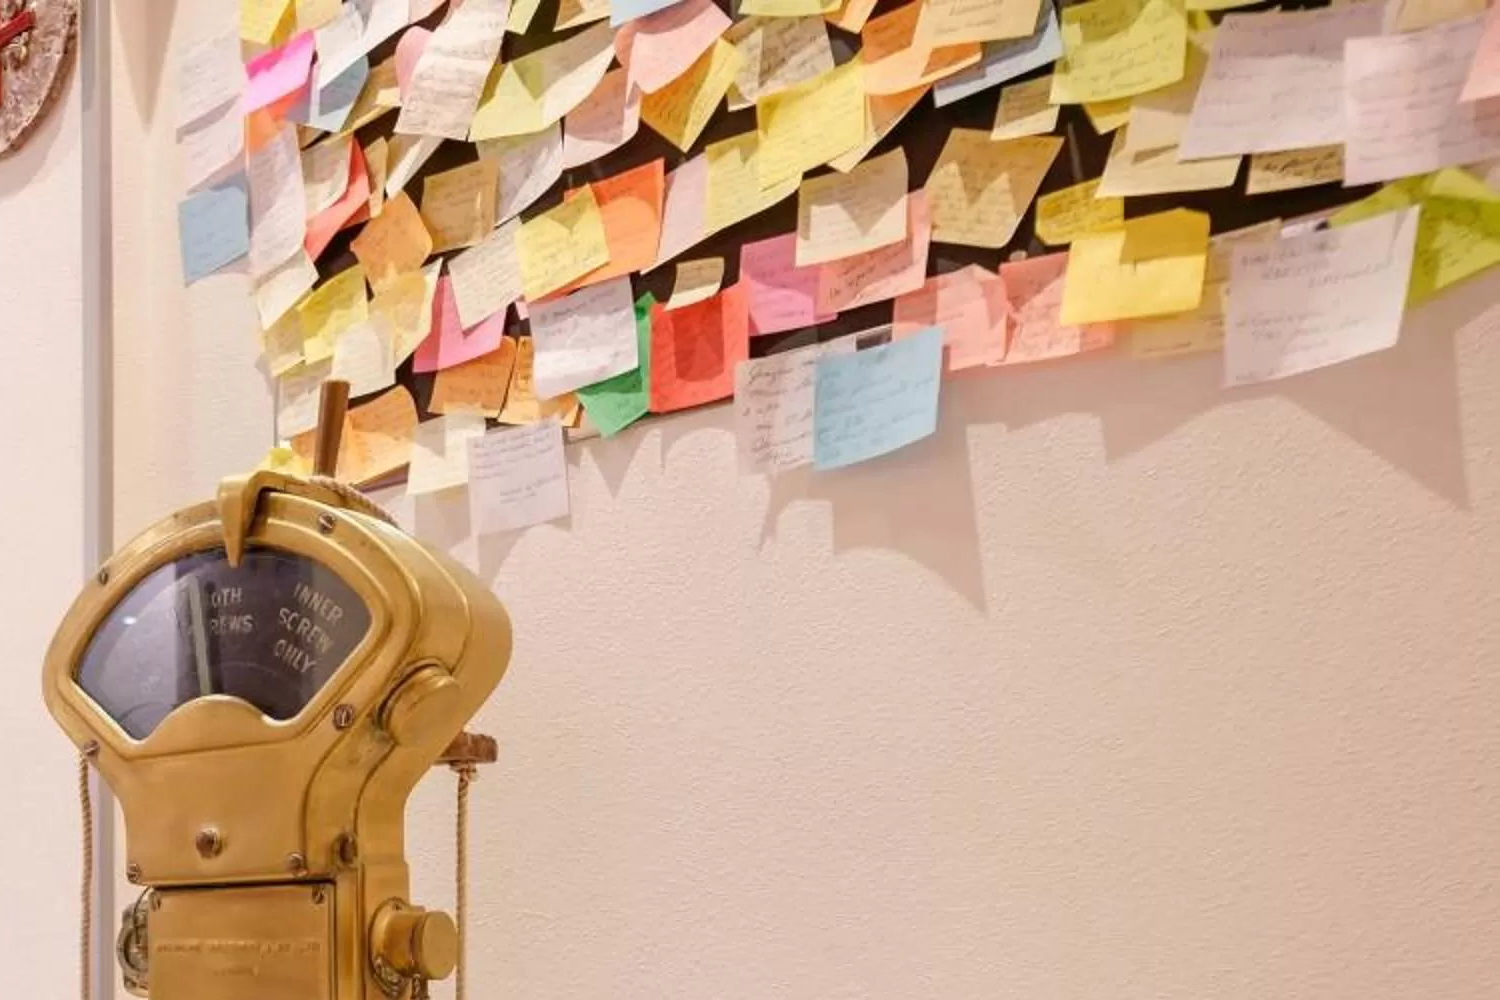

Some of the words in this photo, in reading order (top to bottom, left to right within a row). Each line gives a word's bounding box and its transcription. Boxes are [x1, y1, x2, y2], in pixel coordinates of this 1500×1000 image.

[211, 587, 242, 608] OTH
[293, 582, 343, 624] INNER
[211, 614, 253, 634] REWS
[279, 607, 333, 653] SCREW
[274, 639, 316, 673] ONLY
